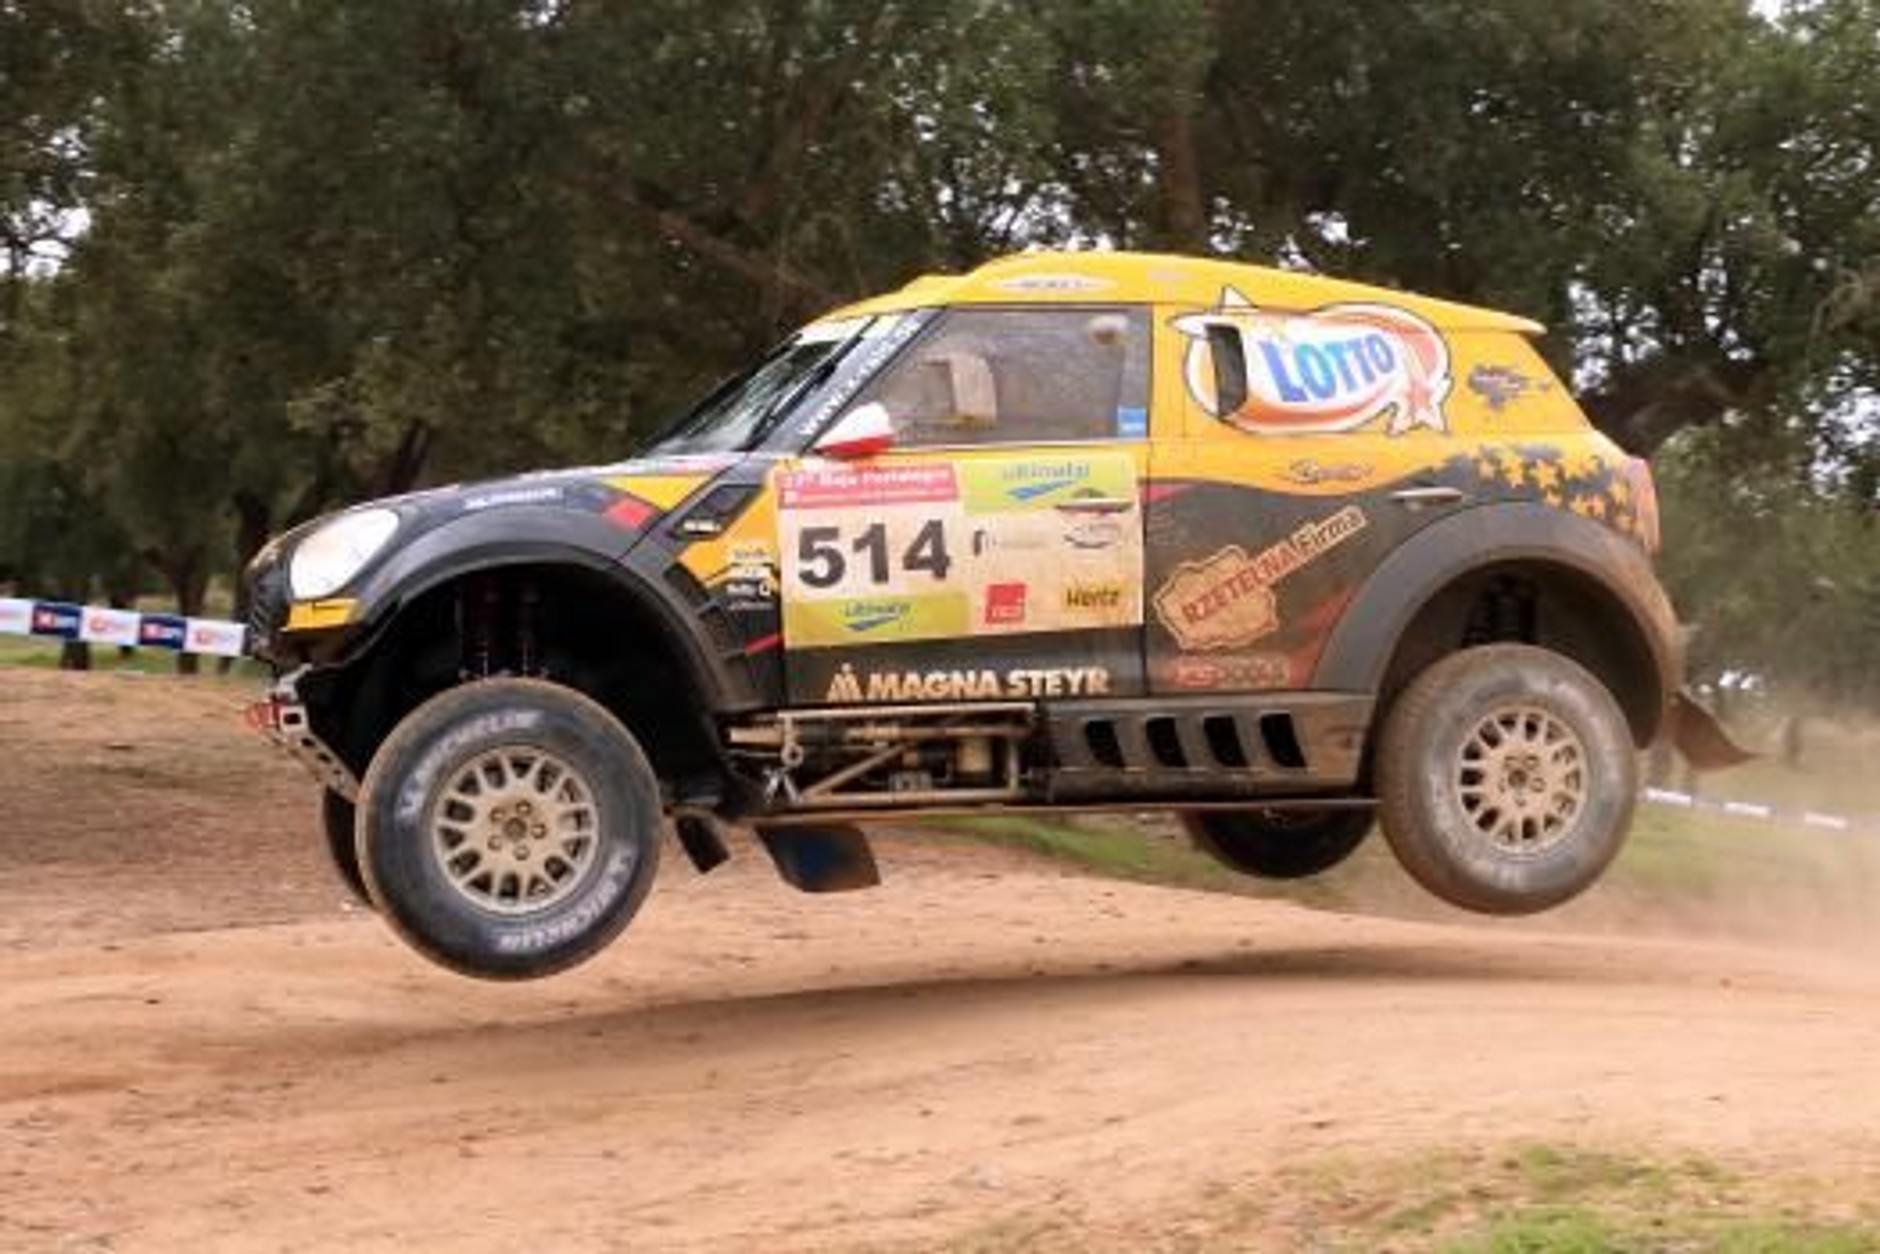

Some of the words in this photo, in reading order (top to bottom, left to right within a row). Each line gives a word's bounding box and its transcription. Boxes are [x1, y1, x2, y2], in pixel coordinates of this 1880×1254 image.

[1260, 333, 1396, 402] LOTTO
[798, 518, 951, 589] 514
[1066, 586, 1119, 608] Hertz
[866, 668, 1001, 699] MAGNA
[1006, 664, 1110, 695] STEYR
